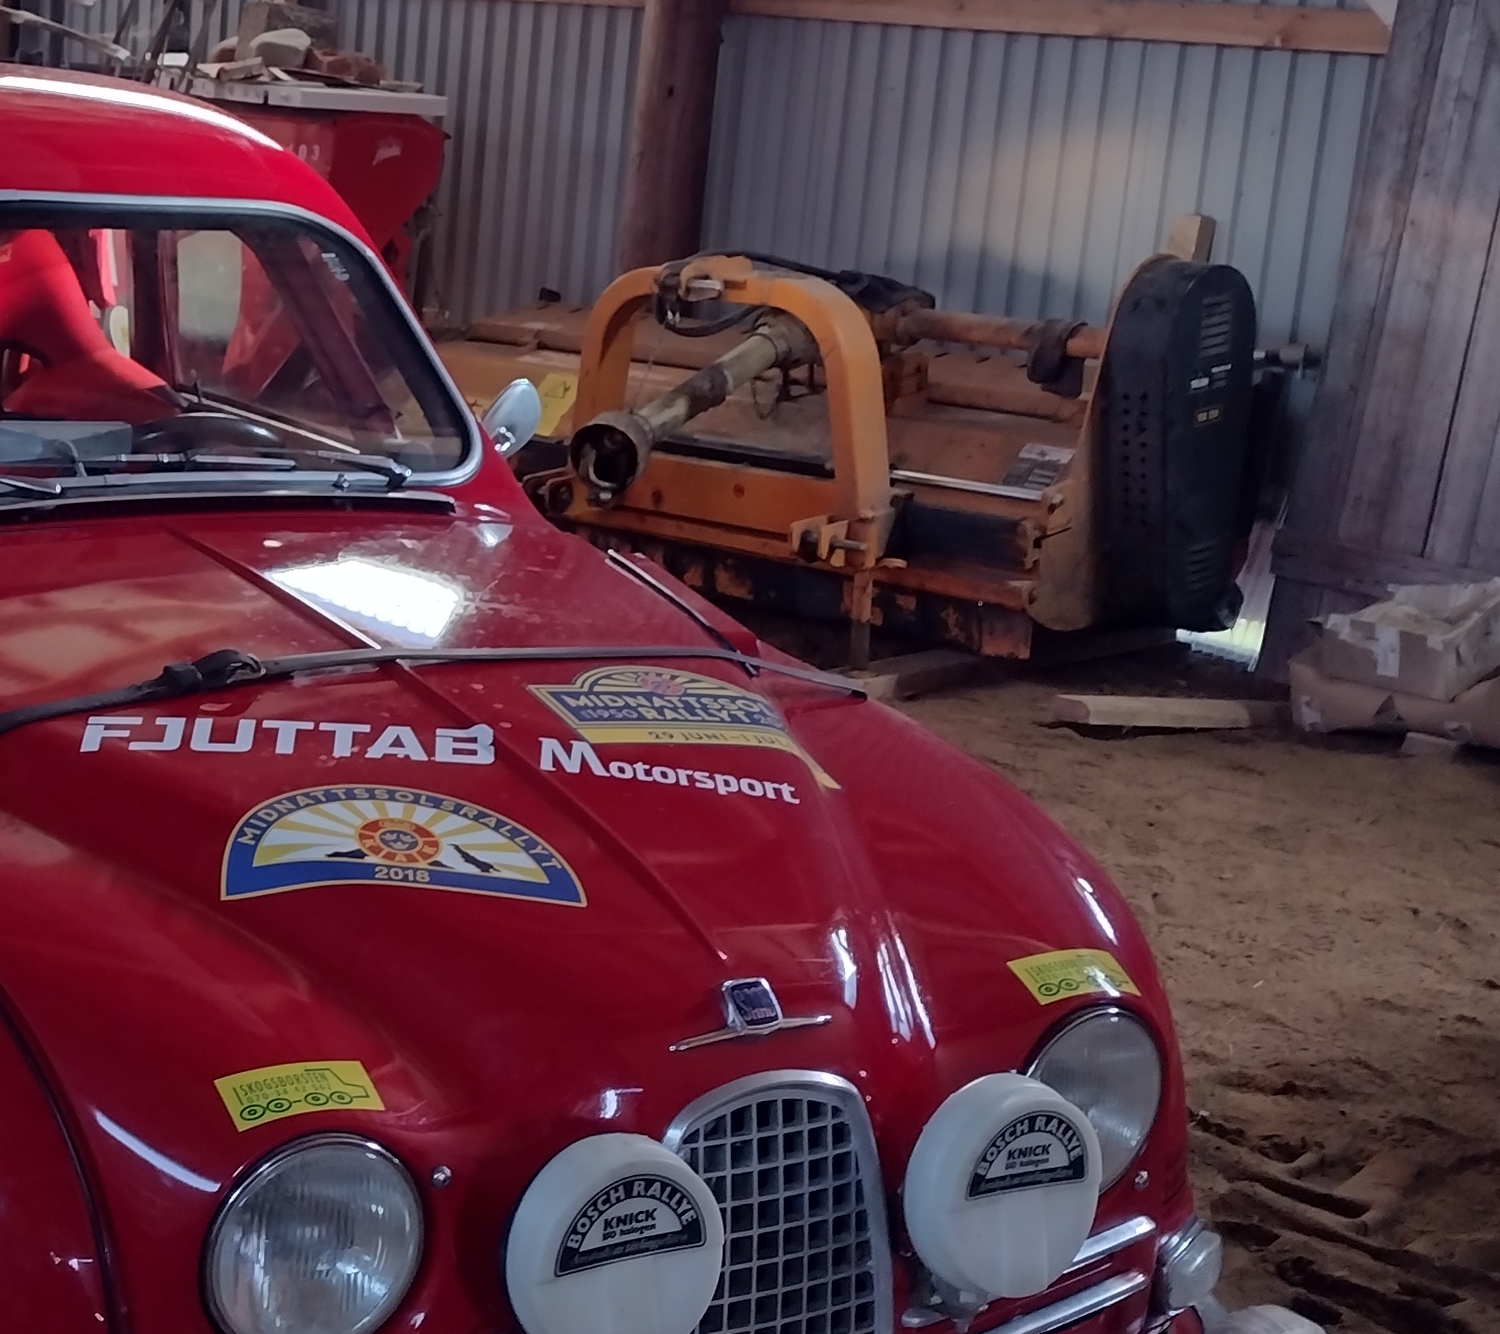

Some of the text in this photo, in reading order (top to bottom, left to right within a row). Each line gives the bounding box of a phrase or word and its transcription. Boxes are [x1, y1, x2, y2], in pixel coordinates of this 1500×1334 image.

[561, 693, 779, 718] MIDNATTSSOL
[637, 706, 751, 724] RALLYT
[648, 731, 674, 742] 29
[79, 715, 800, 805] FJUTTAB Motorsport
[237, 787, 564, 871] MIDNATTSSOLSRALLYT
[374, 866, 431, 883] 2018
[976, 1116, 1083, 1176] BOSCH RALLYE
[1007, 1143, 1052, 1161] KNICK
[566, 1184, 626, 1250] BOSCH
[631, 1180, 698, 1226] RALLYE
[603, 1207, 658, 1232] KNICK
